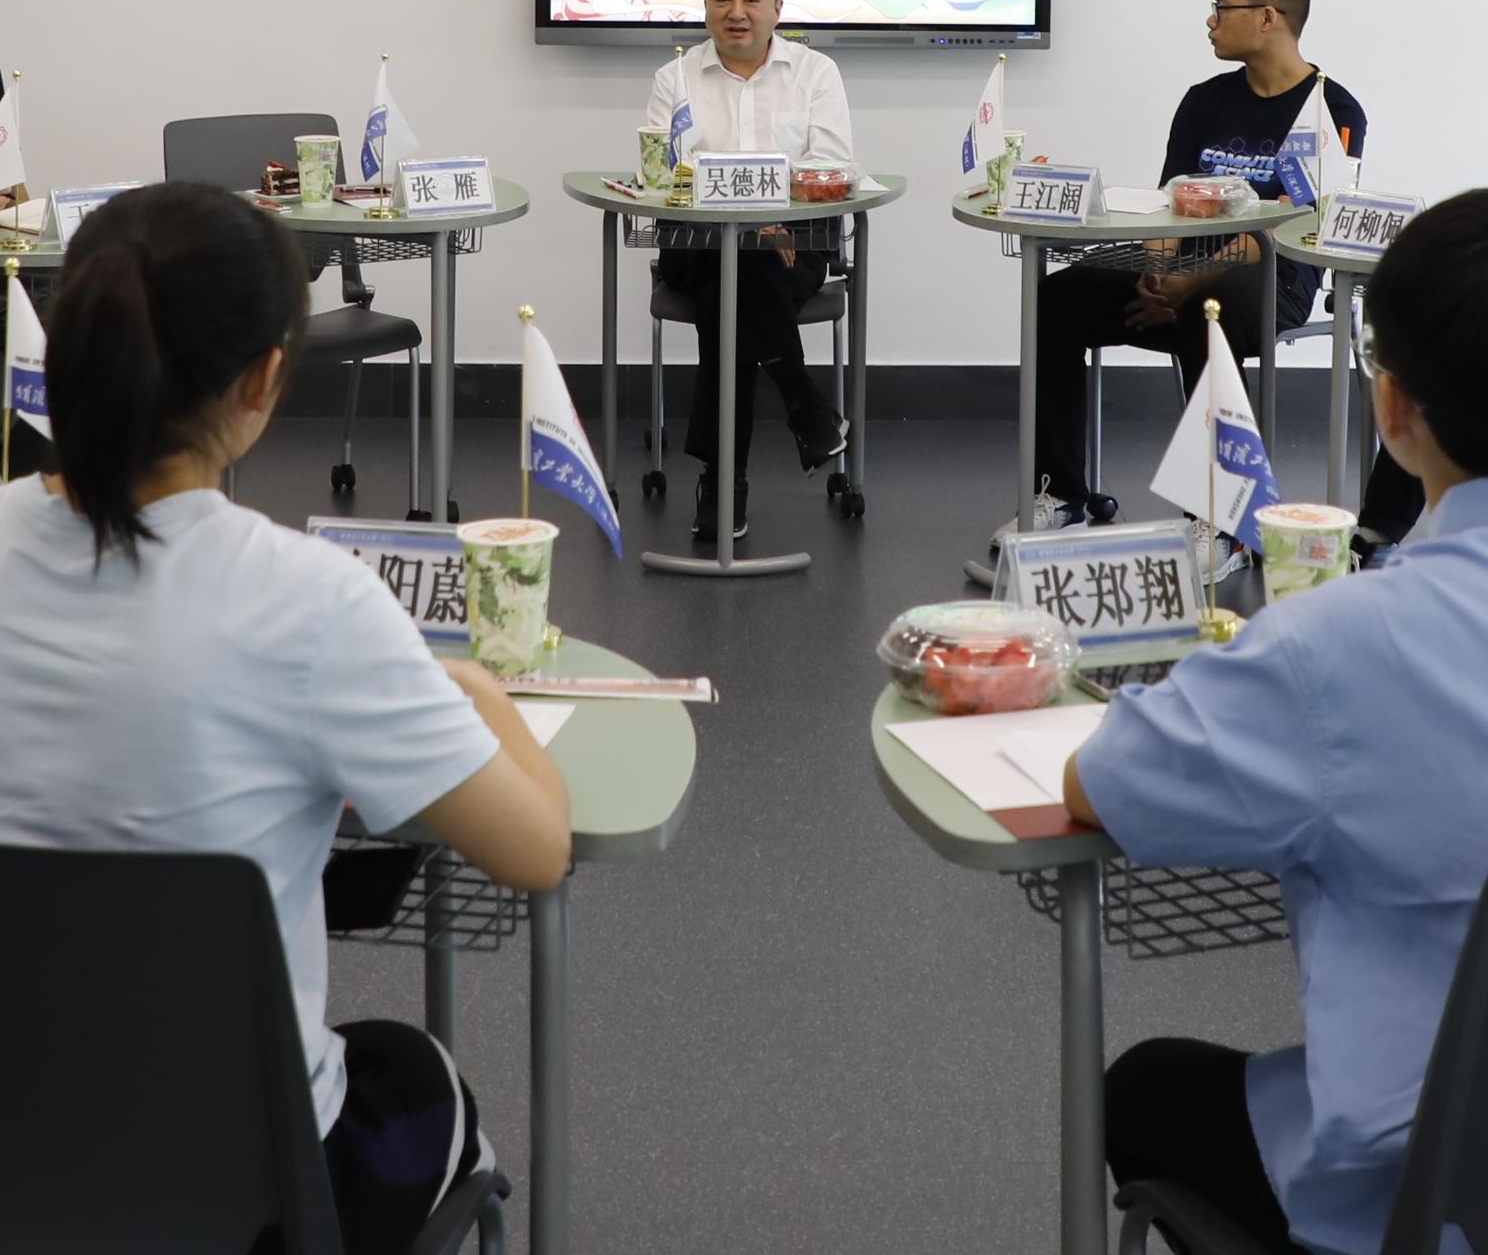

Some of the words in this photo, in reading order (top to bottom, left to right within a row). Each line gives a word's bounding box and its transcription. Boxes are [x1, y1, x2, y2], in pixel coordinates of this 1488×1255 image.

[704, 166, 782, 199] 吴德林
[1010, 181, 1084, 216] 王江阔
[353, 547, 469, 624] 阳蔚
[1031, 555, 1185, 629] 张郑翔
